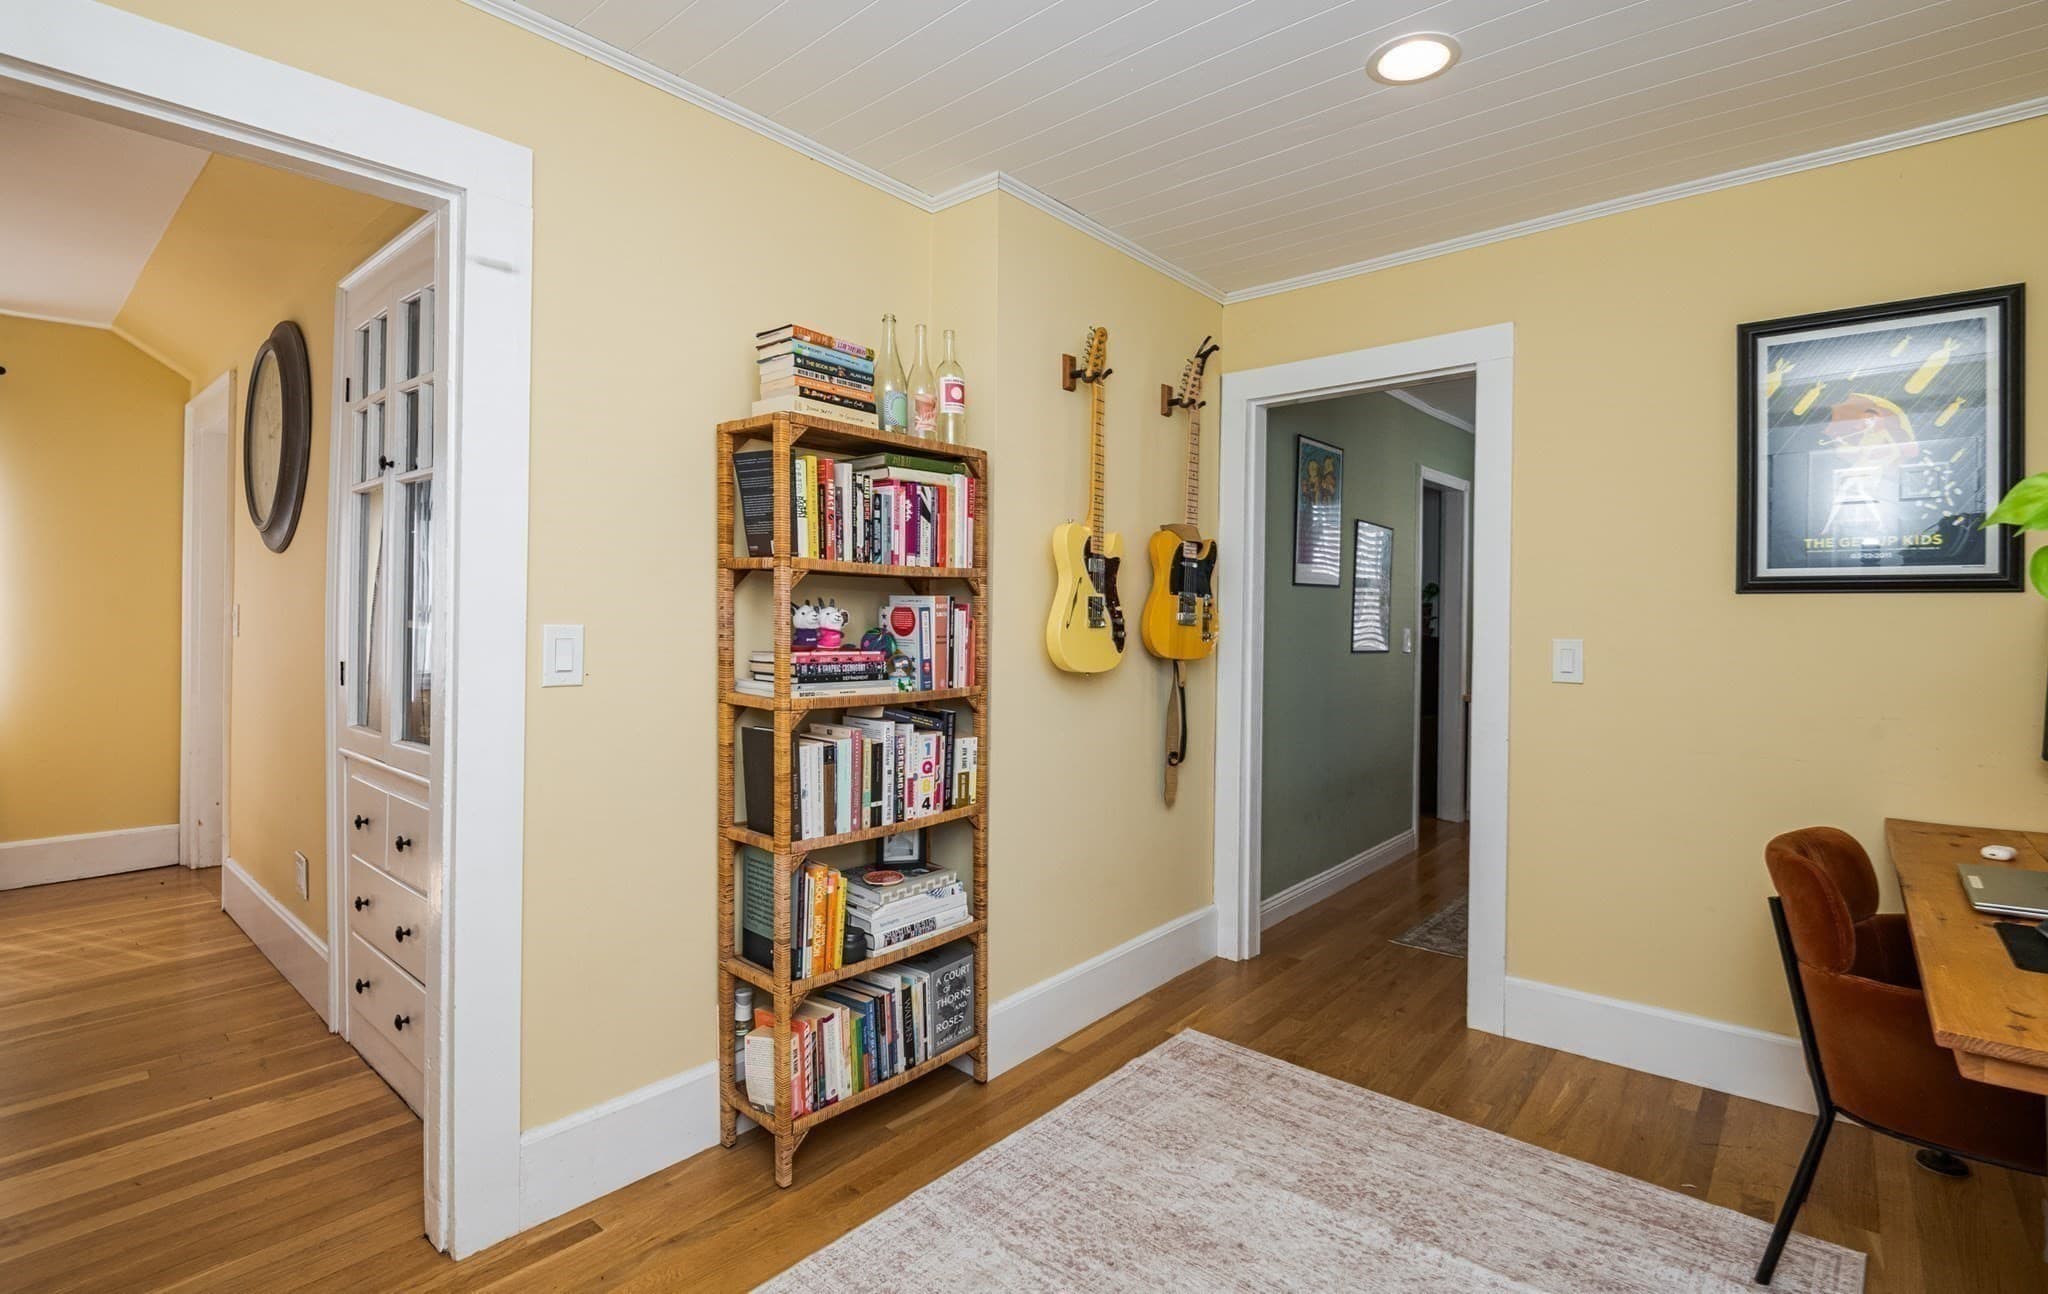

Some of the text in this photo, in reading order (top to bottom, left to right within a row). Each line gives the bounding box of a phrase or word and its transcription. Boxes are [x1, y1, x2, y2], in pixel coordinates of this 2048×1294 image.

[1803, 537, 1834, 549] THE
[1902, 533, 1943, 546] KIDS
[936, 963, 970, 986] A COURT
[936, 986, 971, 1010] THORNS
[955, 1000, 968, 1010] AND
[904, 999, 913, 1043] WALDEN
[936, 1012, 964, 1034] ROSES
